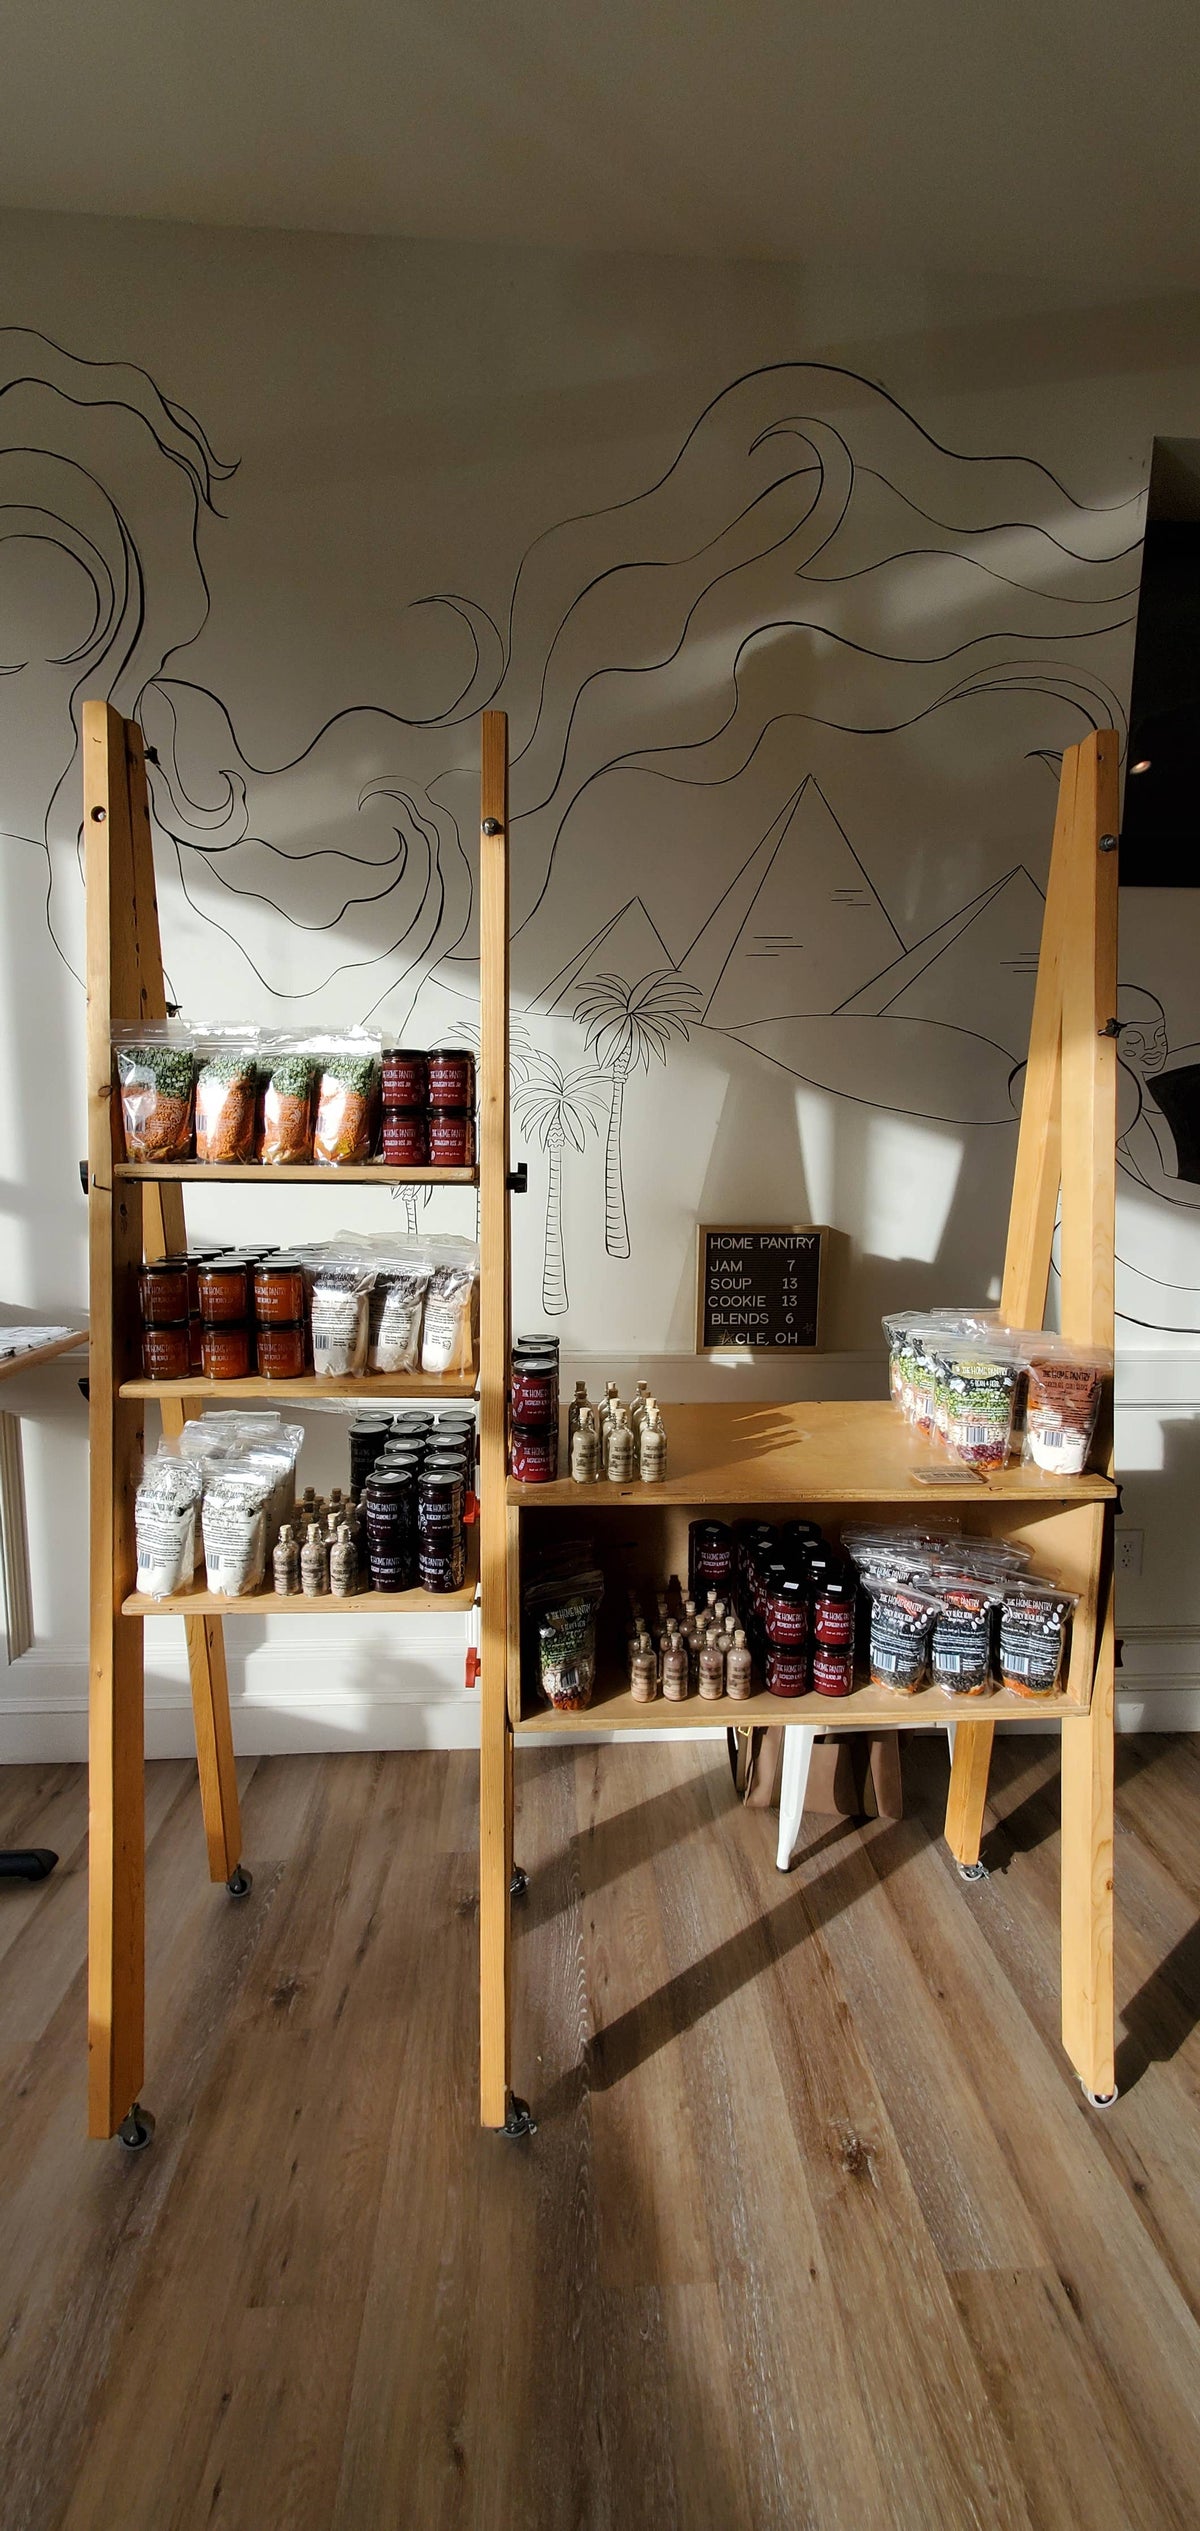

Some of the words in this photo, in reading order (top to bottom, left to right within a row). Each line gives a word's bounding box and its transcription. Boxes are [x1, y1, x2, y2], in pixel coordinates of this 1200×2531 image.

[710, 1237, 753, 1249] HOME
[760, 1237, 815, 1249] PANTRY
[710, 1260, 743, 1272] JAM
[787, 1260, 796, 1272] 7
[710, 1278, 752, 1290] SOUP
[782, 1278, 798, 1290] 13
[708, 1295, 766, 1307] COOKIE
[782, 1295, 798, 1307] 13
[711, 1313, 769, 1325] BLENDS
[785, 1313, 794, 1324] 6
[735, 1332, 770, 1345] CLE,
[775, 1332, 798, 1344] OH
[892, 1569, 910, 1580] PANTRY
[880, 1593, 888, 1603] THE
[888, 1595, 904, 1608] HOME
[903, 1600, 924, 1613] PANTRY
[960, 1596, 980, 1608] PANTRY
[1007, 1598, 1015, 1606] THE
[1015, 1597, 1033, 1609] HOME
[1032, 1600, 1053, 1612] PANTRY
